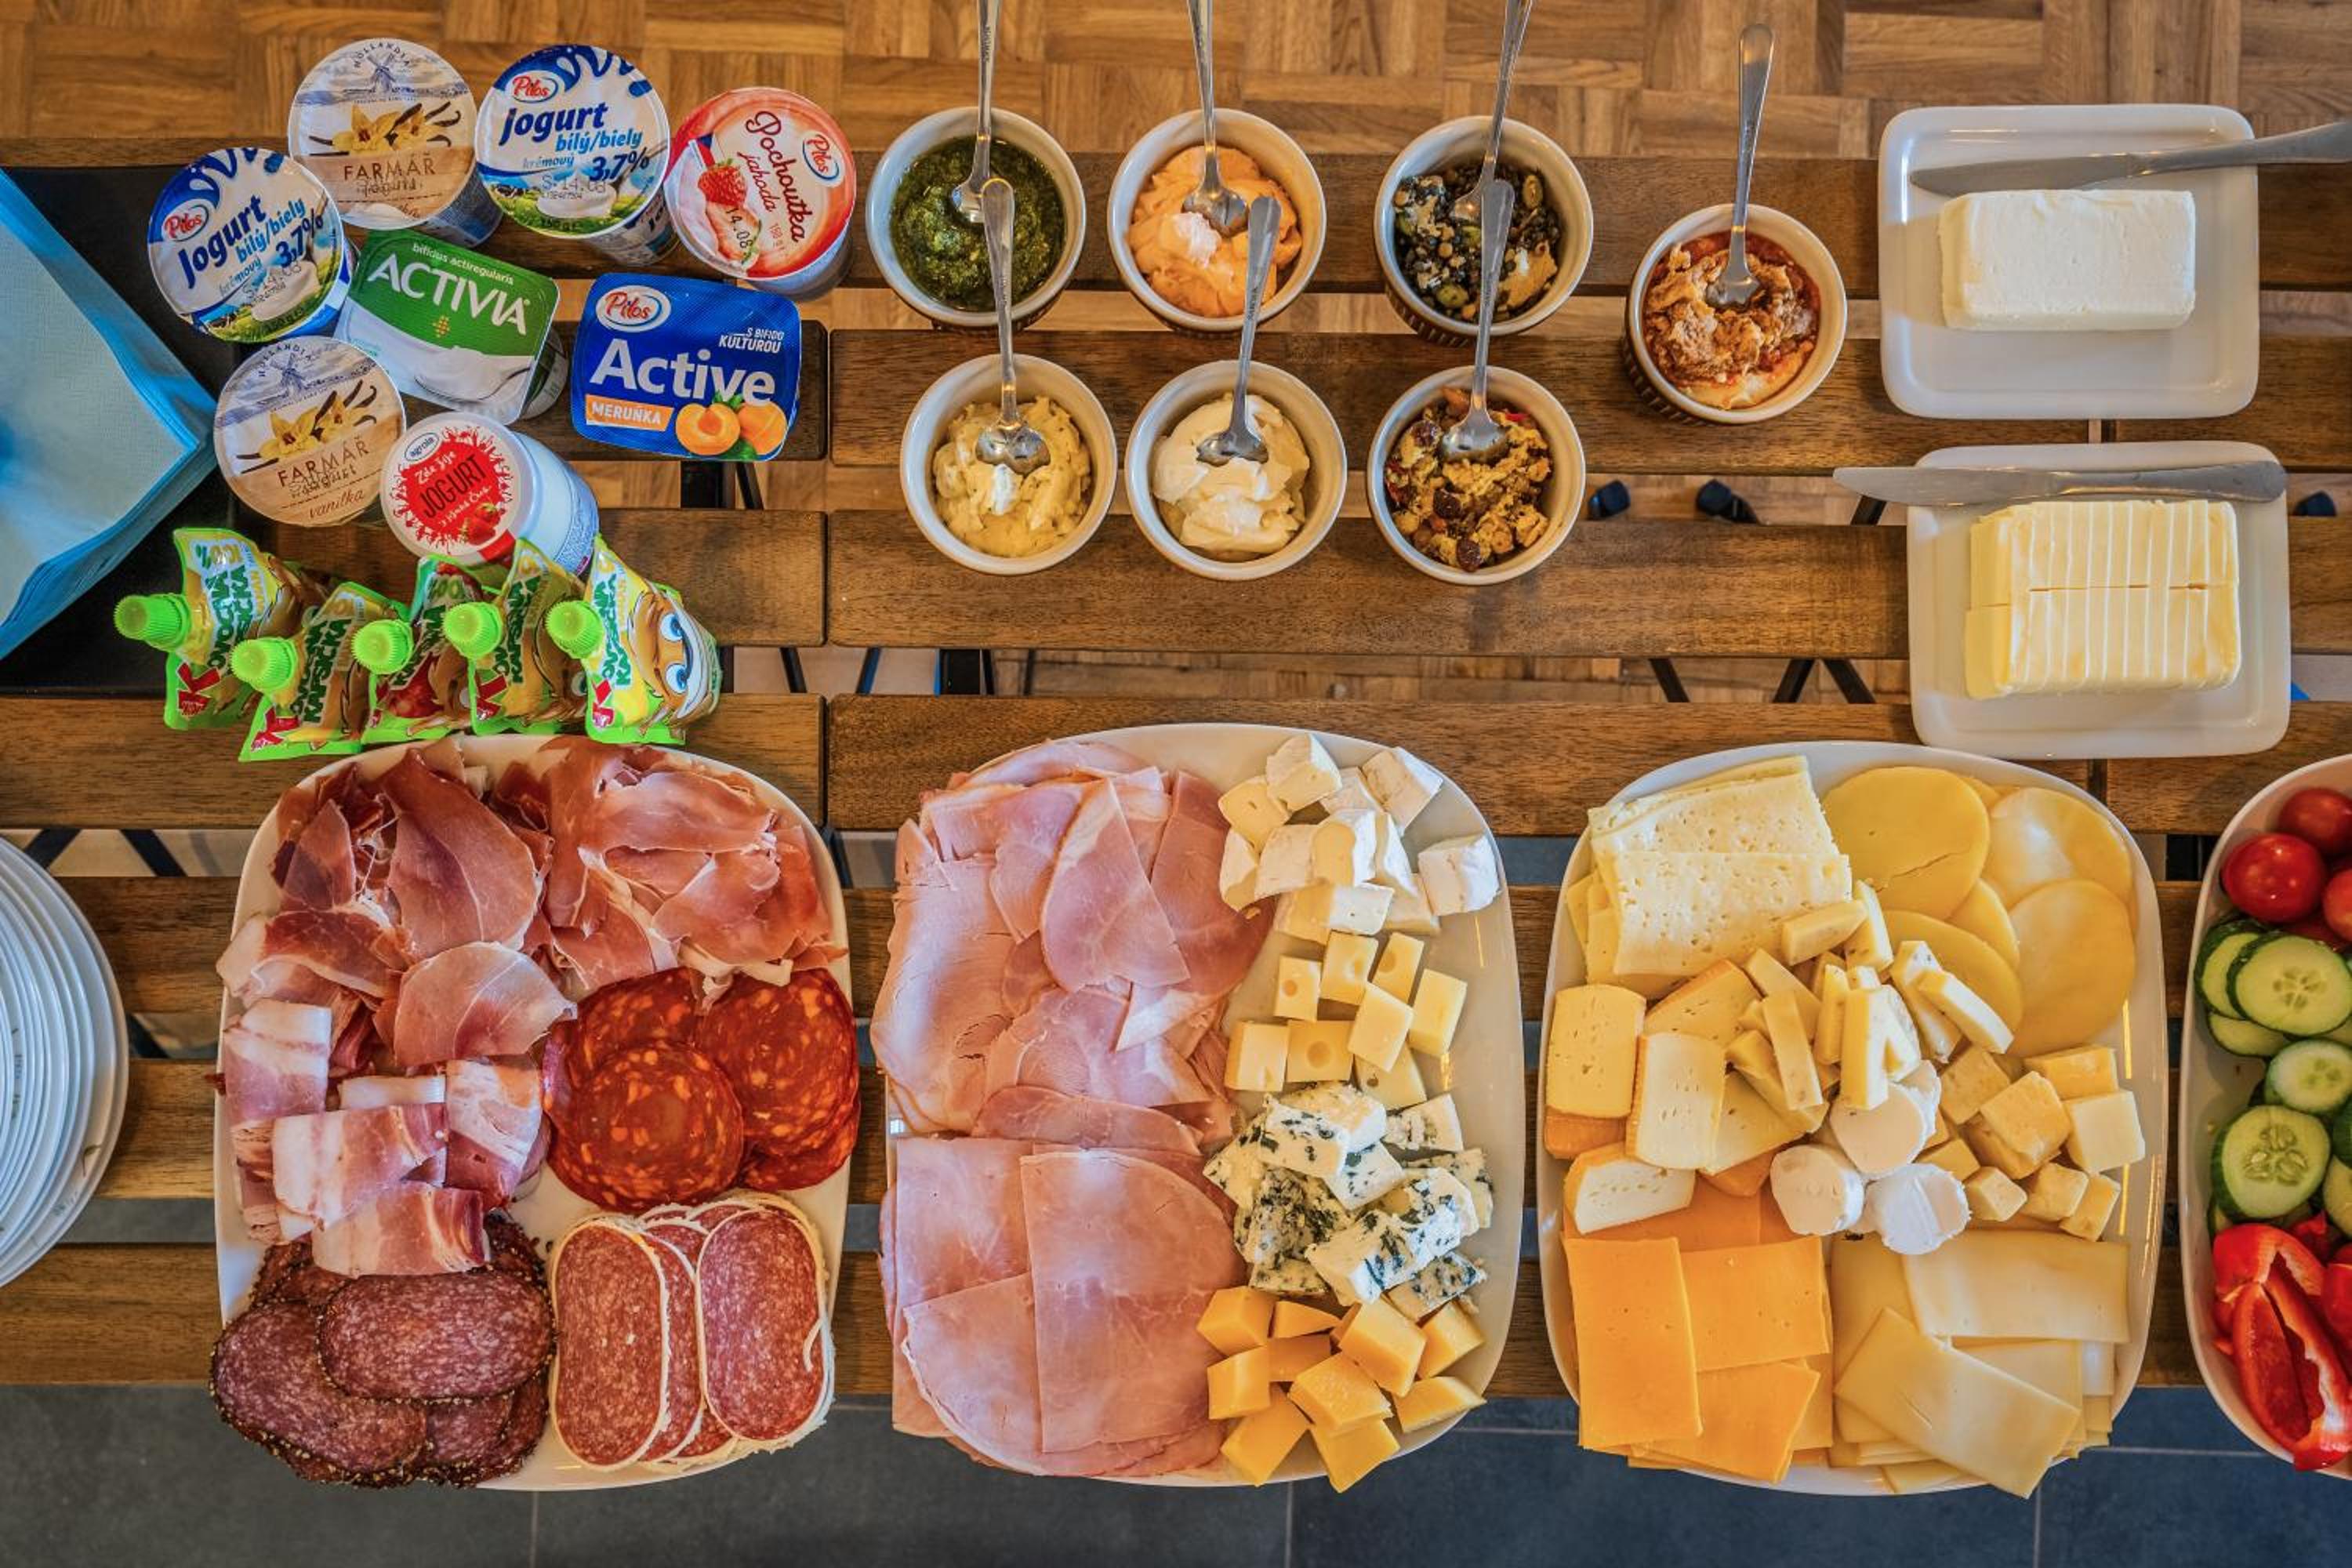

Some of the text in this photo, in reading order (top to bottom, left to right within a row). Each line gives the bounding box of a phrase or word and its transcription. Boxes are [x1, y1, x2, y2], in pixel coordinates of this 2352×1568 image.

[512, 74, 550, 98] Pilos
[589, 147, 650, 182] 3,7%
[808, 133, 831, 173] Pilos
[736, 151, 781, 212] jahoda
[746, 111, 813, 243] Pochoutka
[164, 212, 202, 239] Pilos
[412, 242, 448, 263] bifidus
[367, 252, 527, 336] ACTIVIA
[605, 291, 651, 320] Pilos
[590, 338, 775, 406] Active
[309, 490, 365, 518] vanilka
[419, 454, 487, 518] JOGURT
